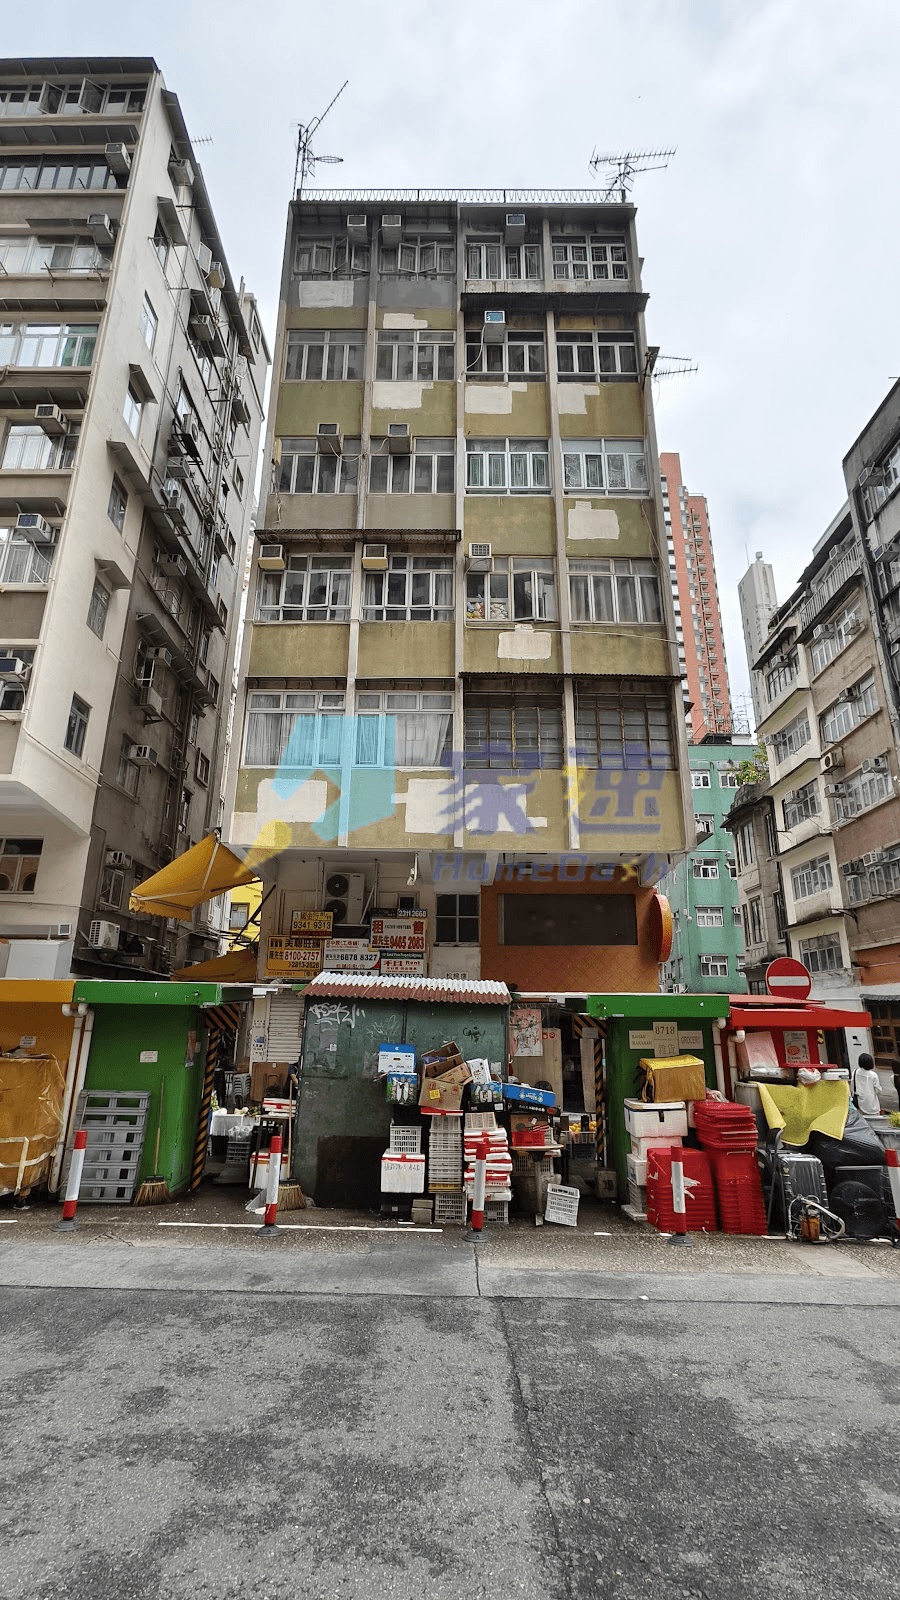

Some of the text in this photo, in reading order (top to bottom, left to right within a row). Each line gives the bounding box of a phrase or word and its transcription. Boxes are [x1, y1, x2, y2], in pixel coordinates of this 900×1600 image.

[293, 921, 331, 930] 9341 9313
[654, 1026, 675, 1035] 8718
